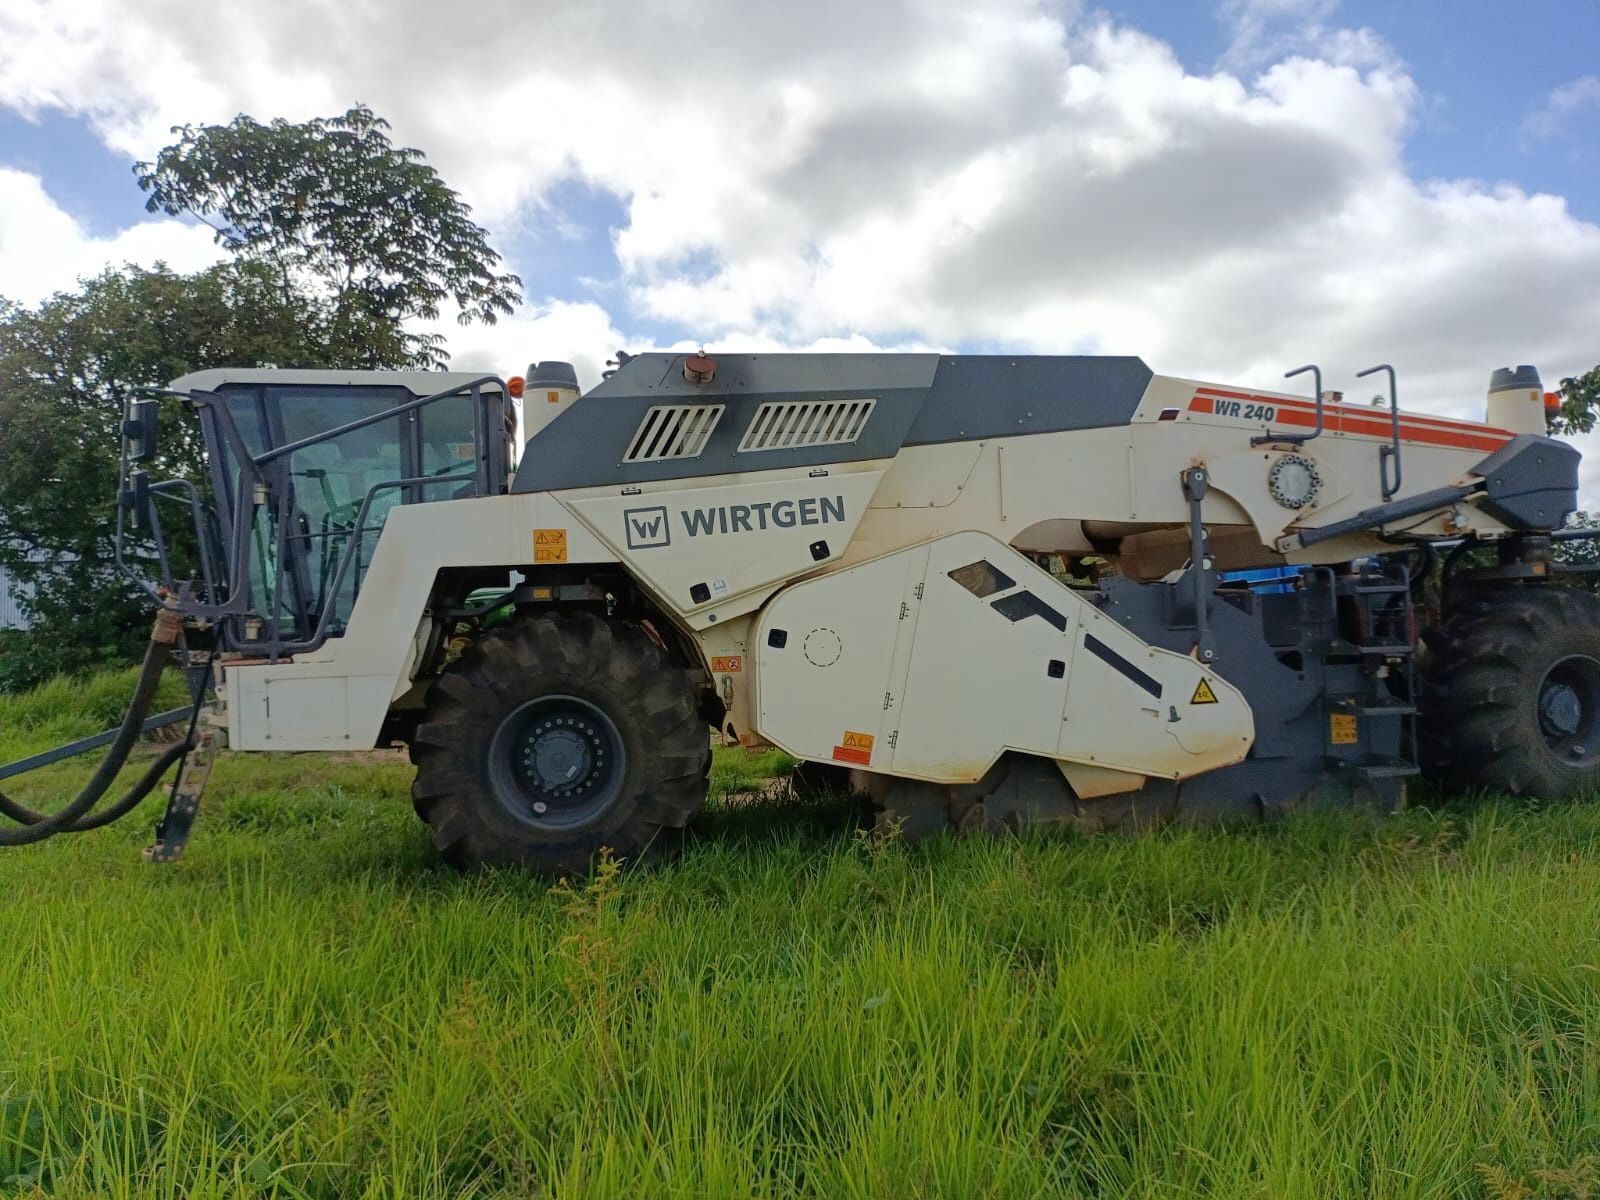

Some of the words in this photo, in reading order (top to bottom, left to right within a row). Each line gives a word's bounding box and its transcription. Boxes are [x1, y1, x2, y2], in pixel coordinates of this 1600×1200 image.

[1215, 400, 1240, 417] WR
[1244, 404, 1274, 421] 240
[631, 516, 662, 539] W
[681, 495, 846, 537] WIRTGEN
